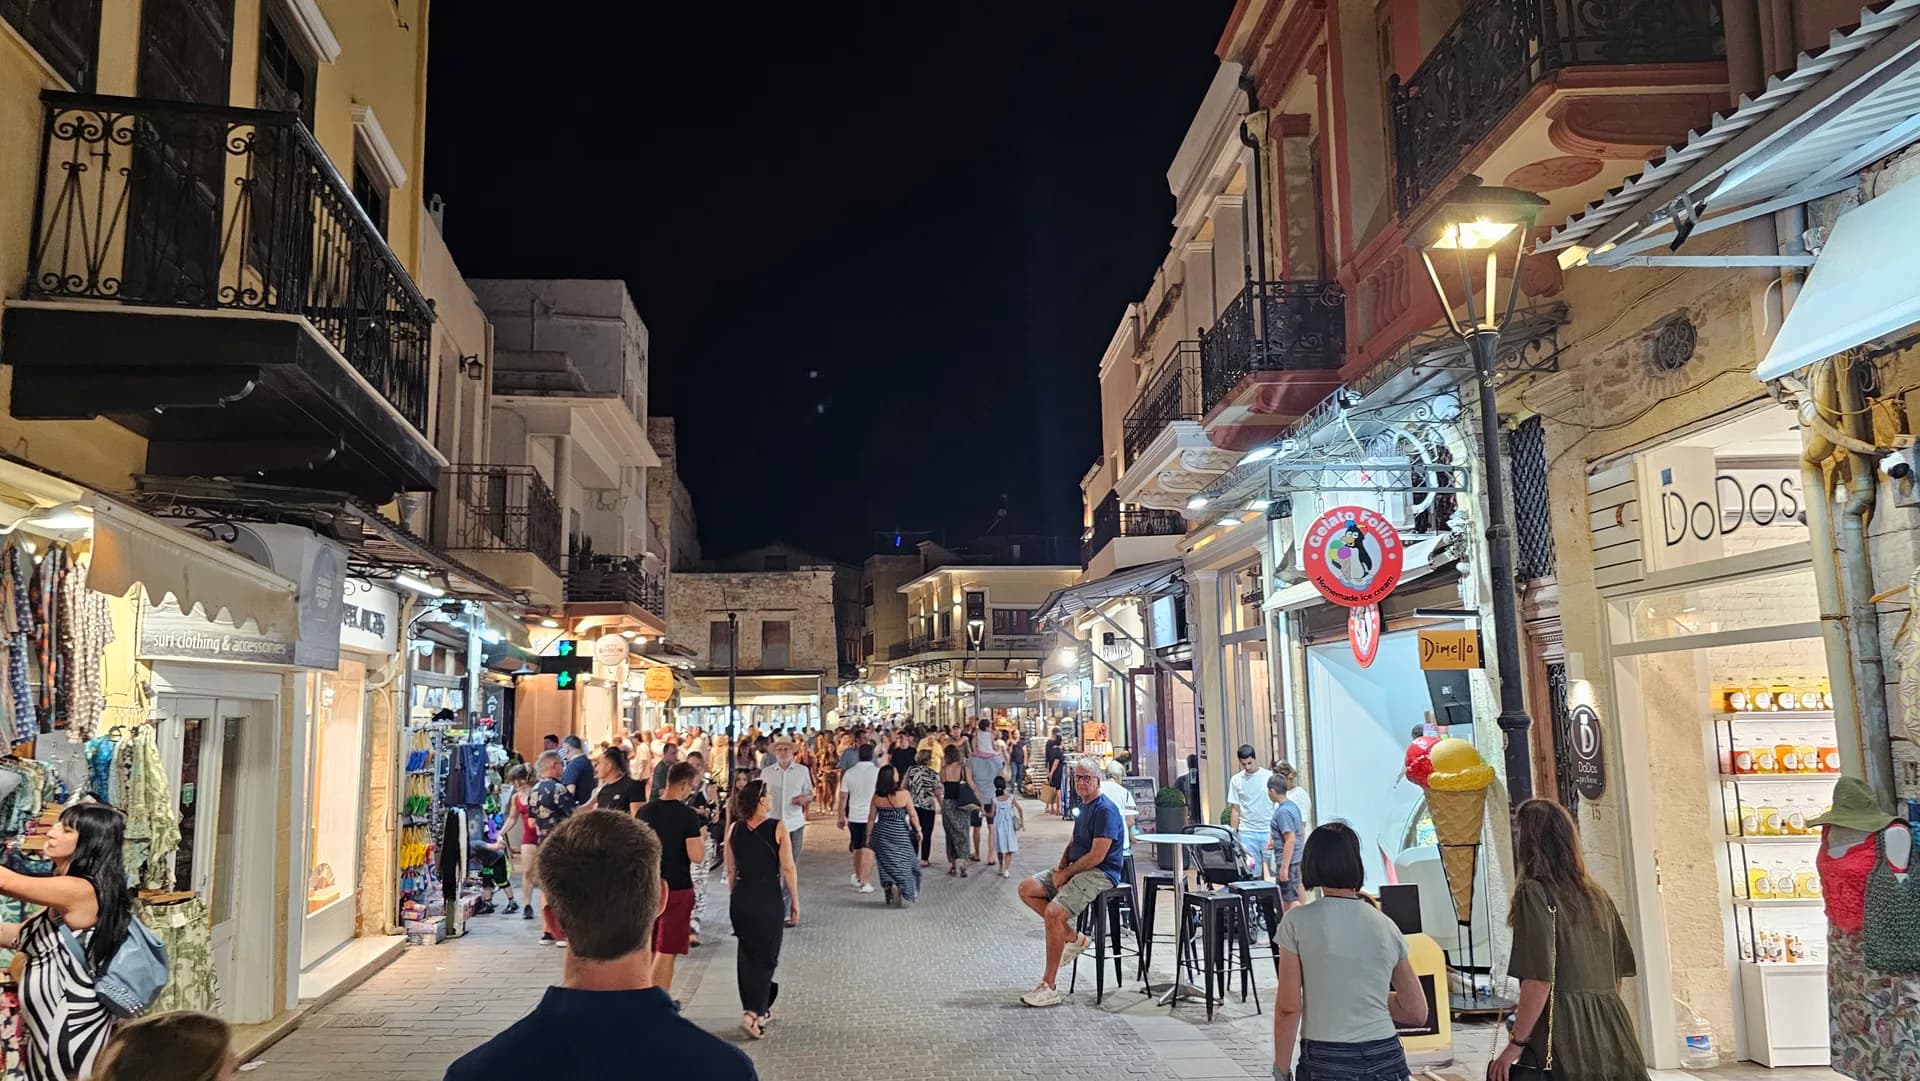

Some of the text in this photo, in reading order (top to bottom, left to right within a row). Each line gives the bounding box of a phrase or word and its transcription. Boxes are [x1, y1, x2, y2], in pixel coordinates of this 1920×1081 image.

[1309, 510, 1395, 548] Gelato Follia
[1316, 576, 1359, 602] Homemade
[1374, 576, 1394, 596] cream
[153, 631, 287, 655] surf clothing & accessories
[1420, 637, 1473, 662] Dimello
[1591, 803, 1601, 820] 15
